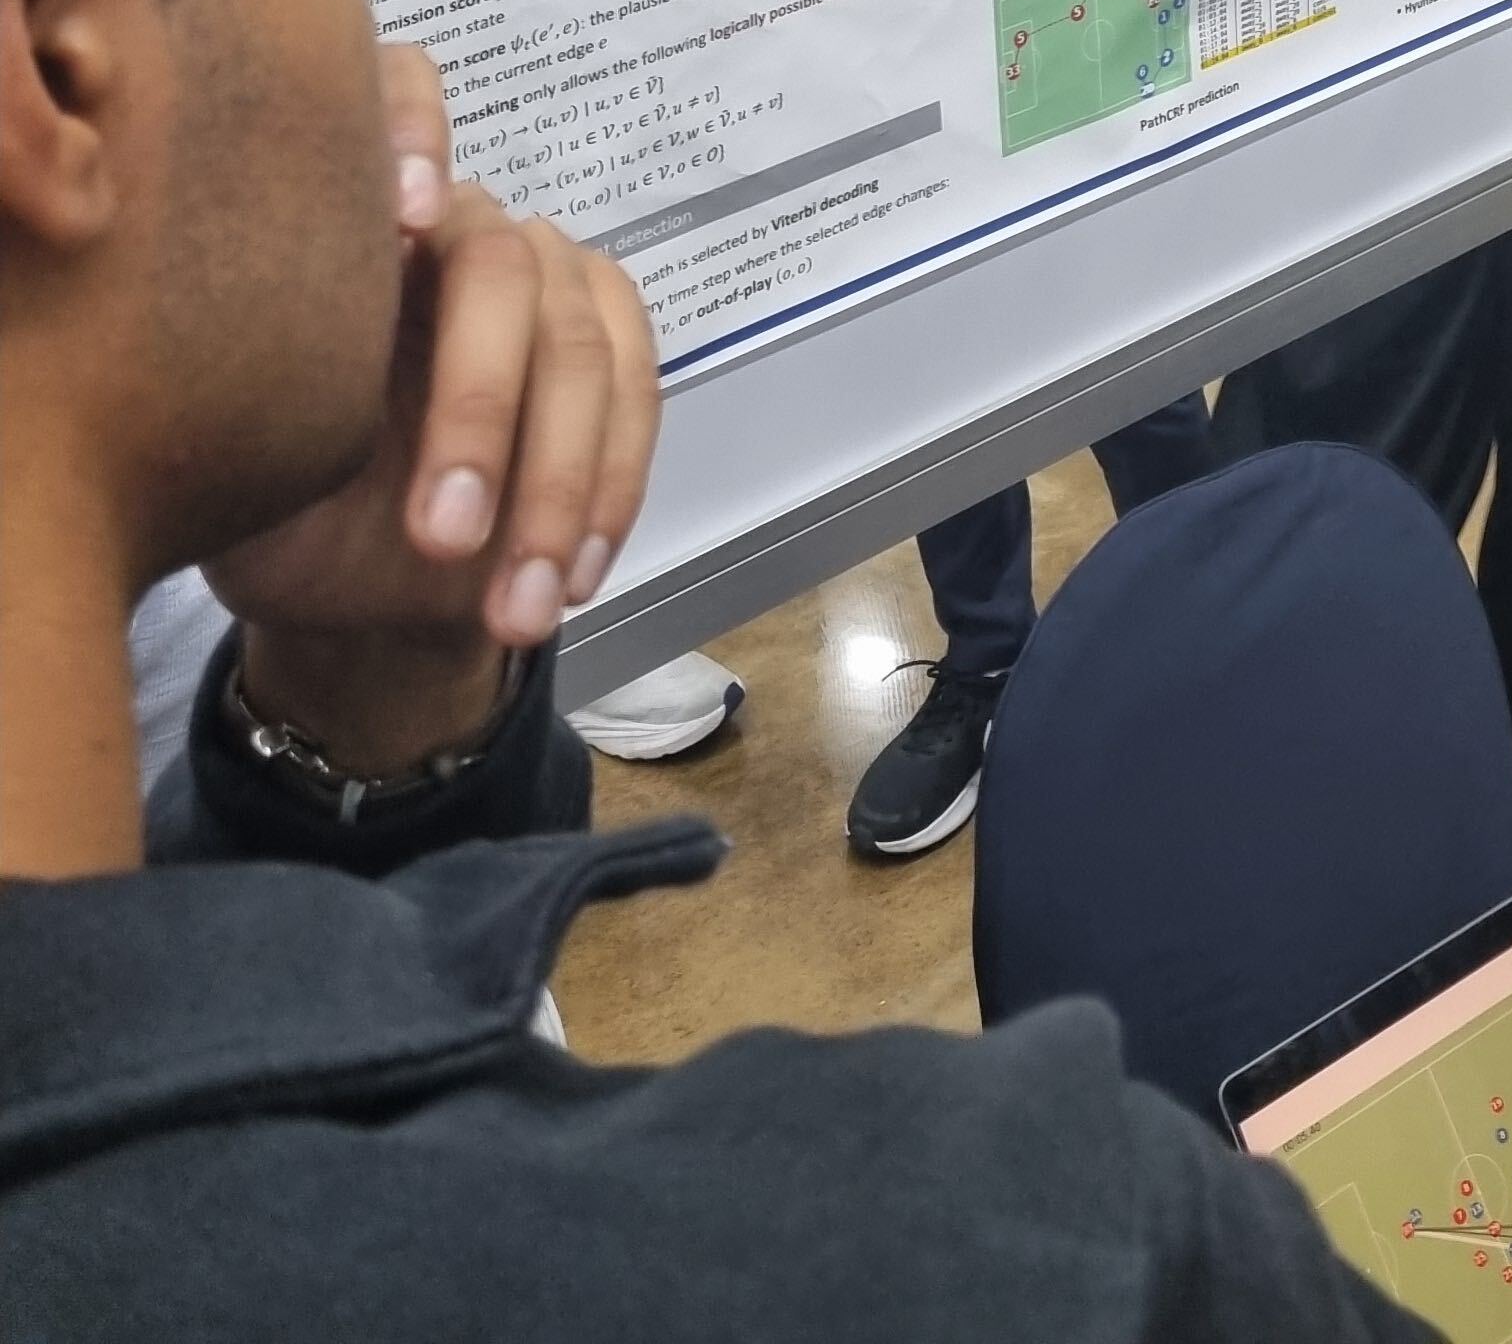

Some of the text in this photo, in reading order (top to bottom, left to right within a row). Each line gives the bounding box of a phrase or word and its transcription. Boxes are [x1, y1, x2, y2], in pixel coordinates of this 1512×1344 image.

[454, 96, 519, 129] masking
[523, 83, 556, 104] only
[560, 67, 609, 92] allows
[612, 58, 637, 75] the
[641, 34, 706, 65] following
[709, 12, 766, 41] logically
[1139, 82, 1239, 131] PathCRF prediction
[615, 215, 693, 256] detection
[642, 179, 879, 290] path is selected by Viterbi decoding
